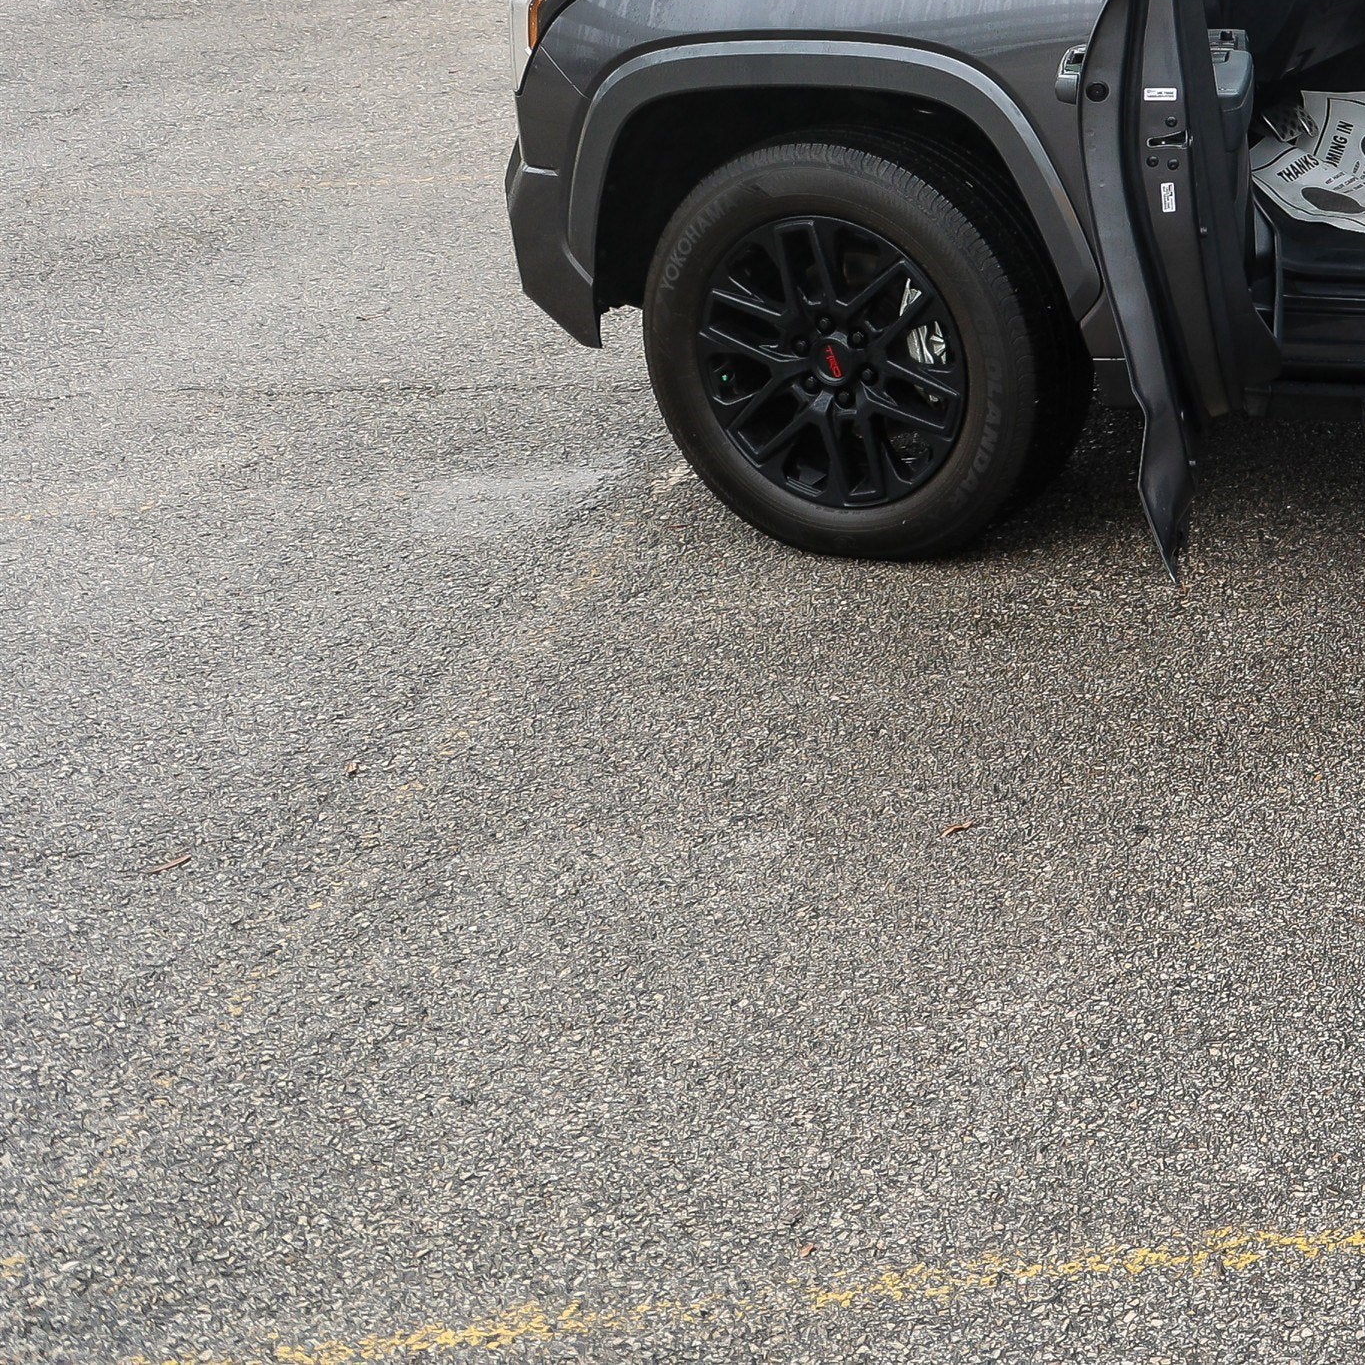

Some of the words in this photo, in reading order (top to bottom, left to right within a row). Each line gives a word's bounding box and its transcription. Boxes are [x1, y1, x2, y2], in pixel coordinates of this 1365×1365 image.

[1336, 120, 1354, 135] IN
[1276, 154, 1320, 183] THANKS
[825, 344, 843, 378] TRD
